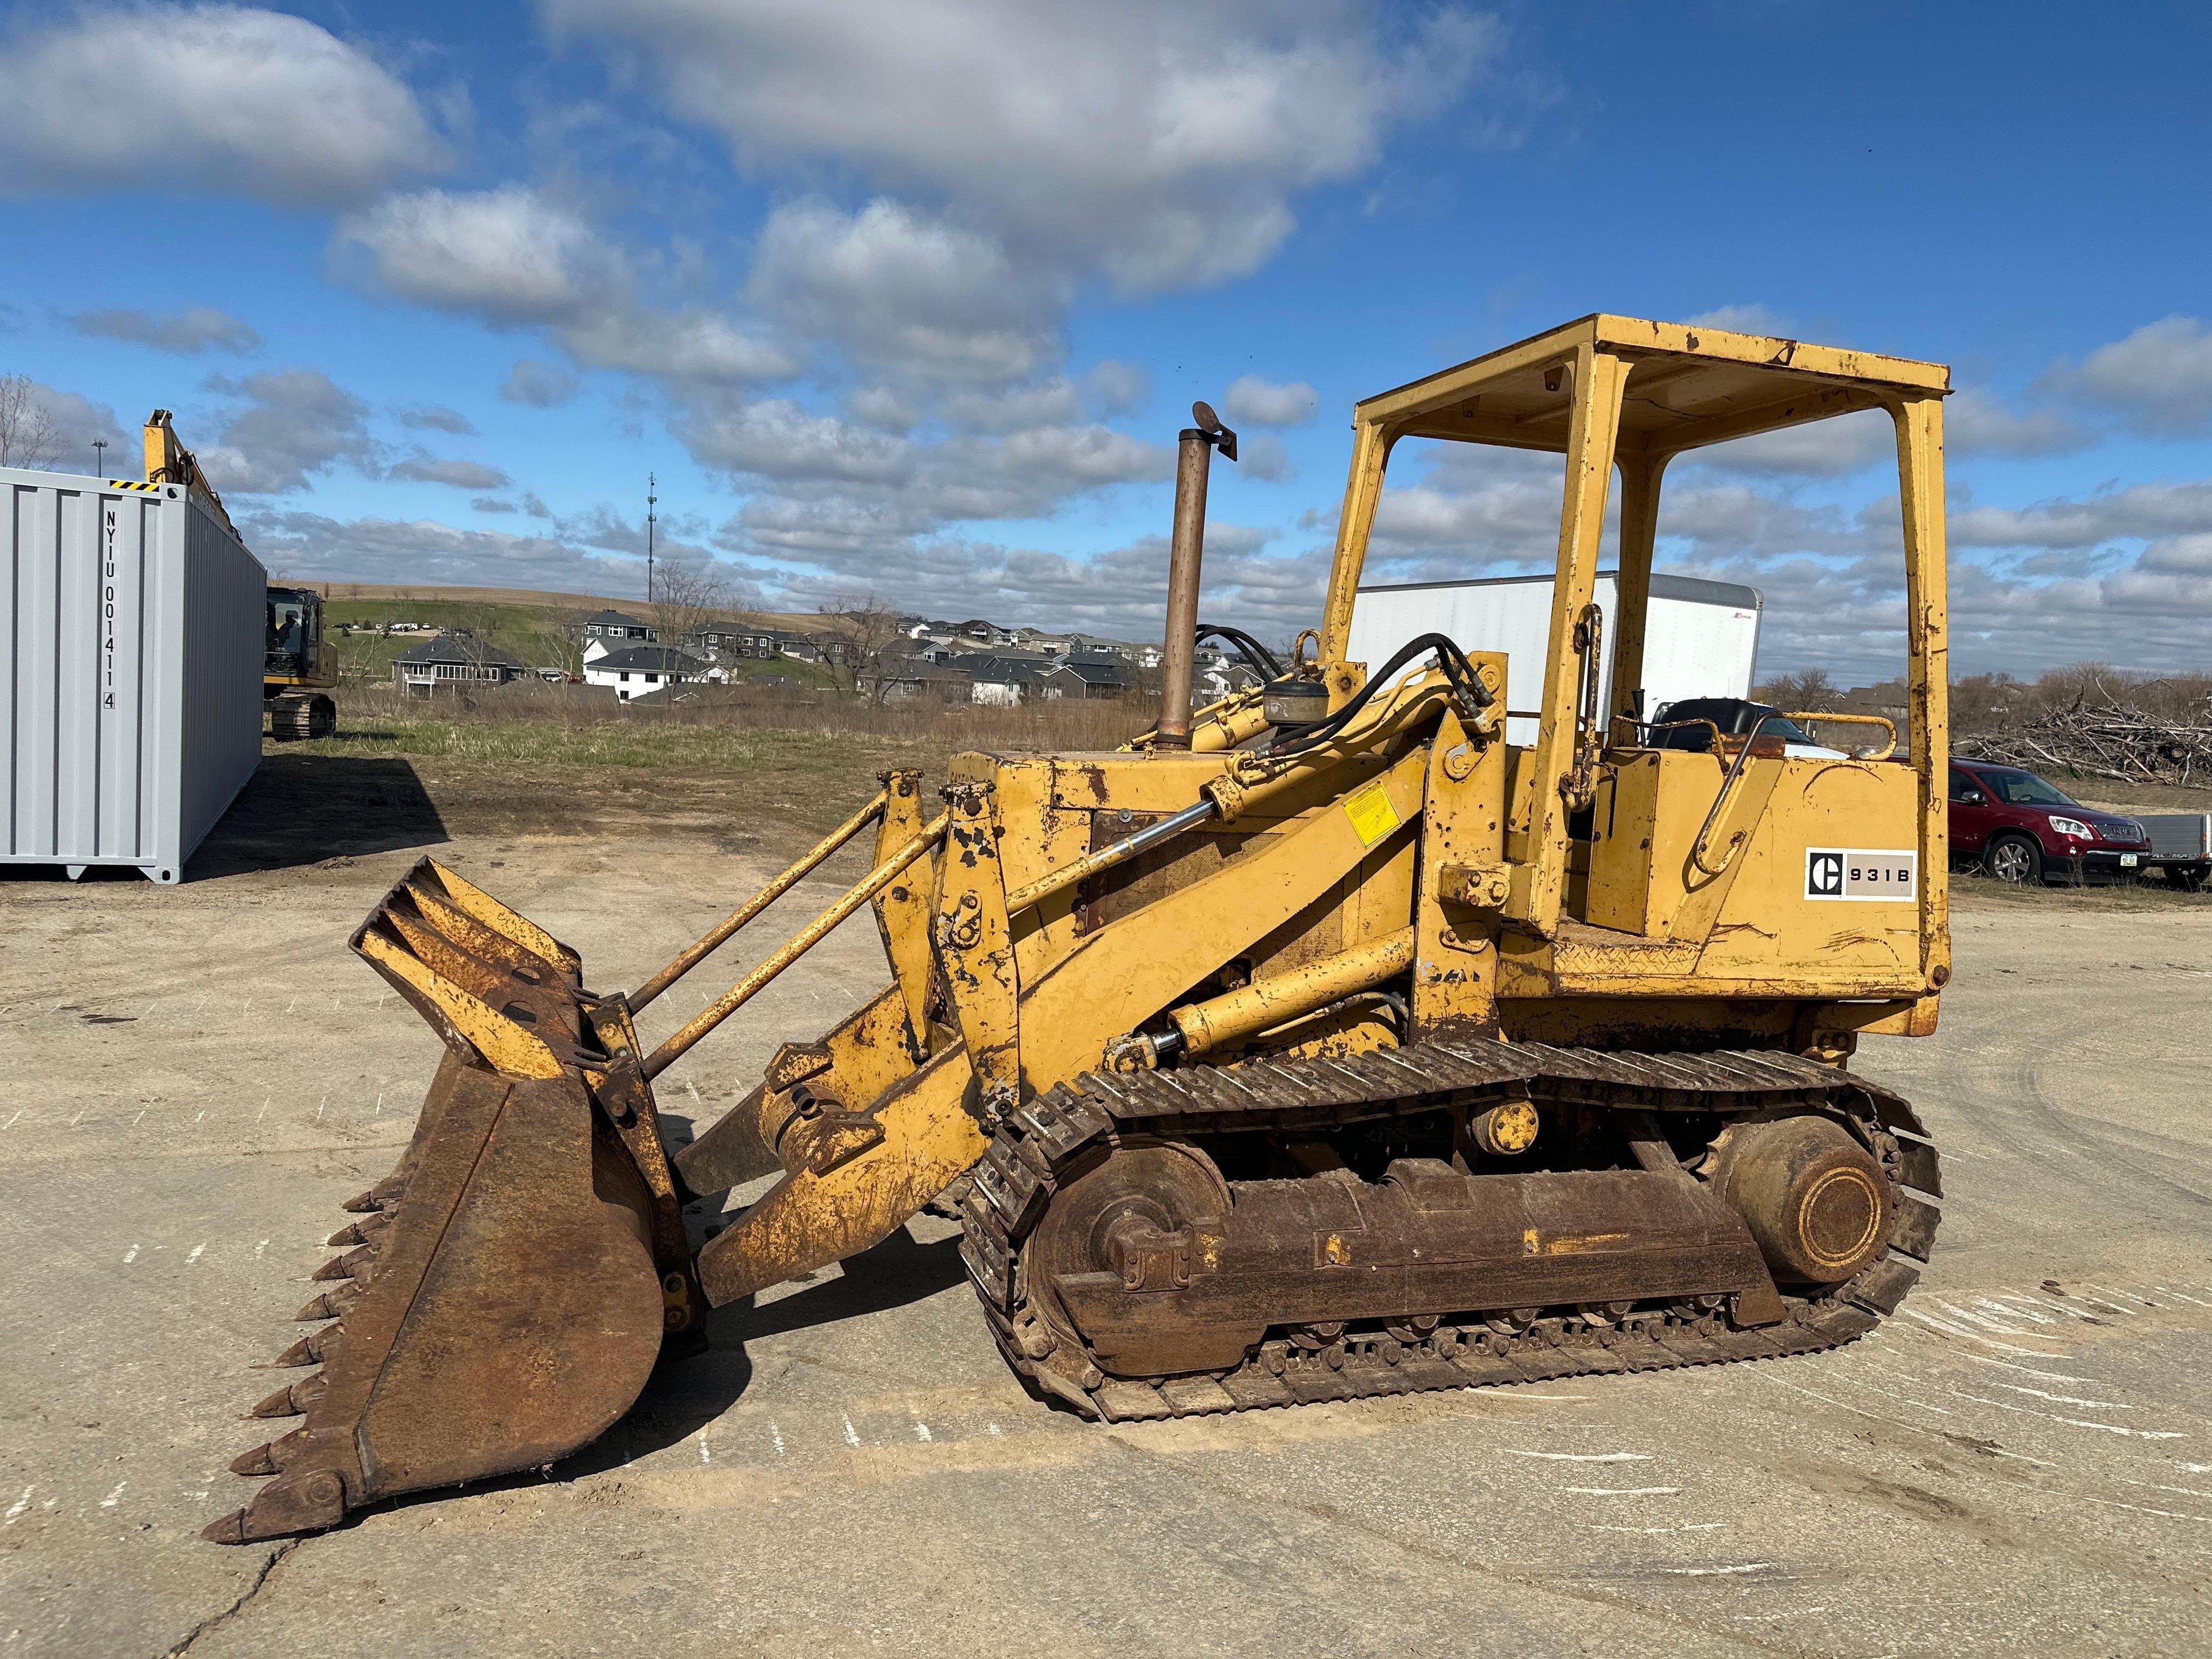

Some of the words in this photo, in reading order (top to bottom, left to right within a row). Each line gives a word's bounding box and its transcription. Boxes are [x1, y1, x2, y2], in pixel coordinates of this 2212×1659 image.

[106, 510, 115, 578] NYIU
[105, 586, 114, 686] 001411
[105, 693, 114, 709] 4
[1850, 868, 1909, 882] 931B
